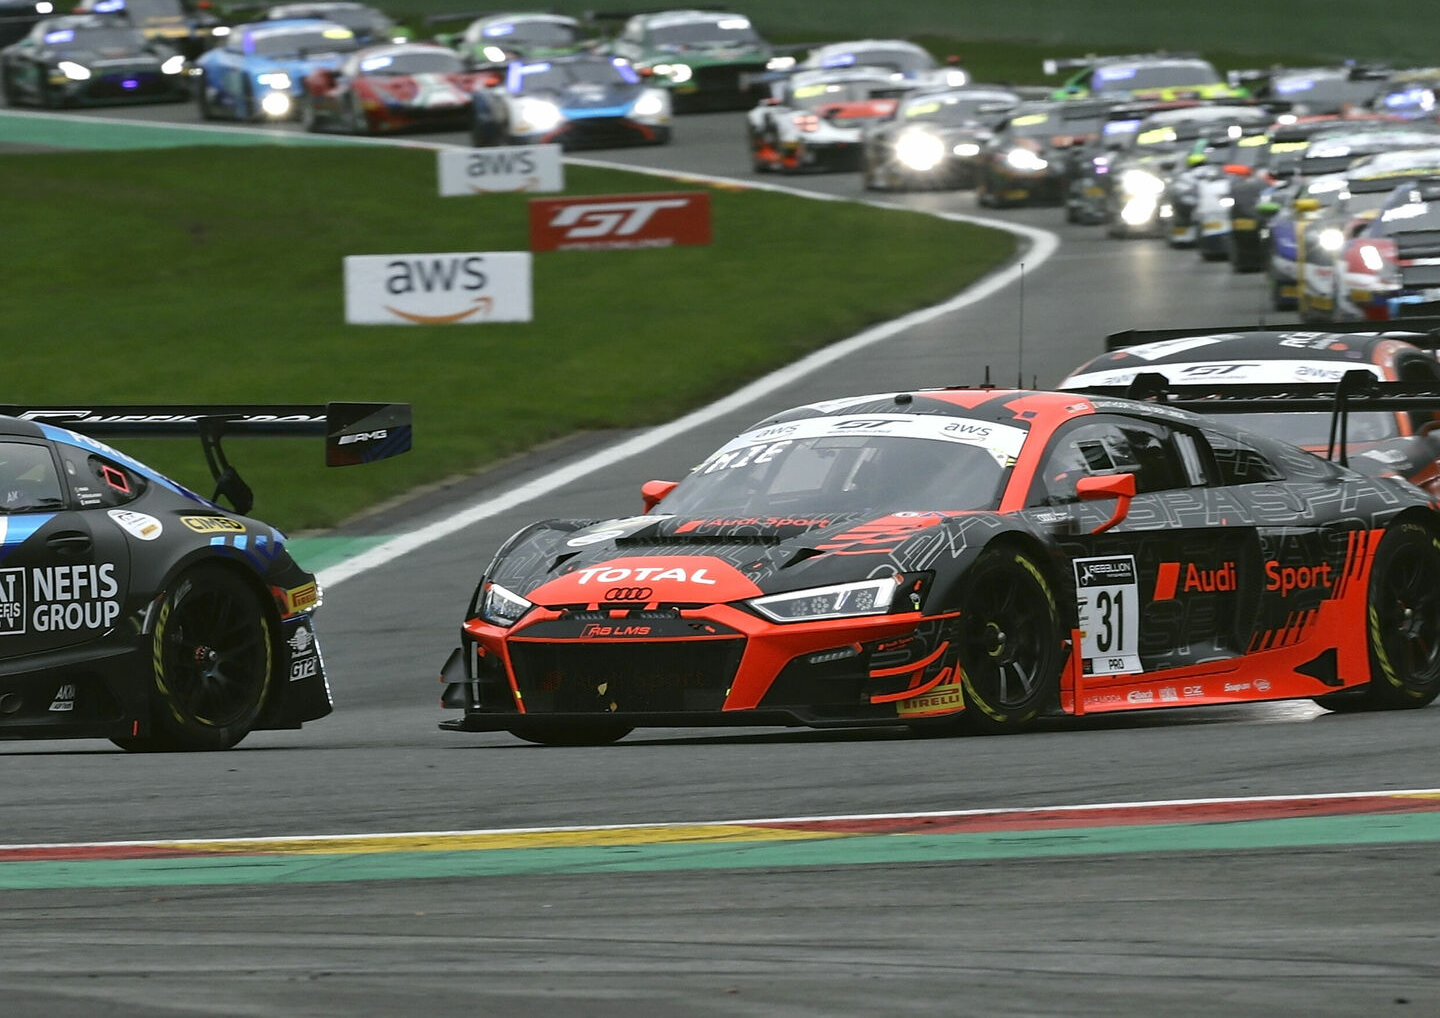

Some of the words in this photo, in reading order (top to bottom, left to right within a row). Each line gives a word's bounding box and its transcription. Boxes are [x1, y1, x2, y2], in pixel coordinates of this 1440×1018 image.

[466, 150, 537, 177] aws
[550, 199, 690, 239] GT
[385, 256, 488, 295] aws
[832, 419, 912, 429] GT
[943, 421, 993, 437] aws
[186, 517, 243, 531] CIMED
[704, 517, 762, 528] Audi
[764, 517, 830, 528] Sport
[33, 563, 118, 602] NEFIS
[577, 566, 716, 585] TOTAL
[1184, 562, 1236, 592] Audi
[1265, 560, 1332, 598] Sport
[33, 600, 120, 631] GROUP
[1096, 590, 1123, 652] 31
[588, 626, 612, 636] R8
[613, 626, 652, 635] LMS
[1108, 659, 1125, 670] PRO
[903, 688, 960, 710] PIRELLI
[1183, 686, 1202, 695] OZ
